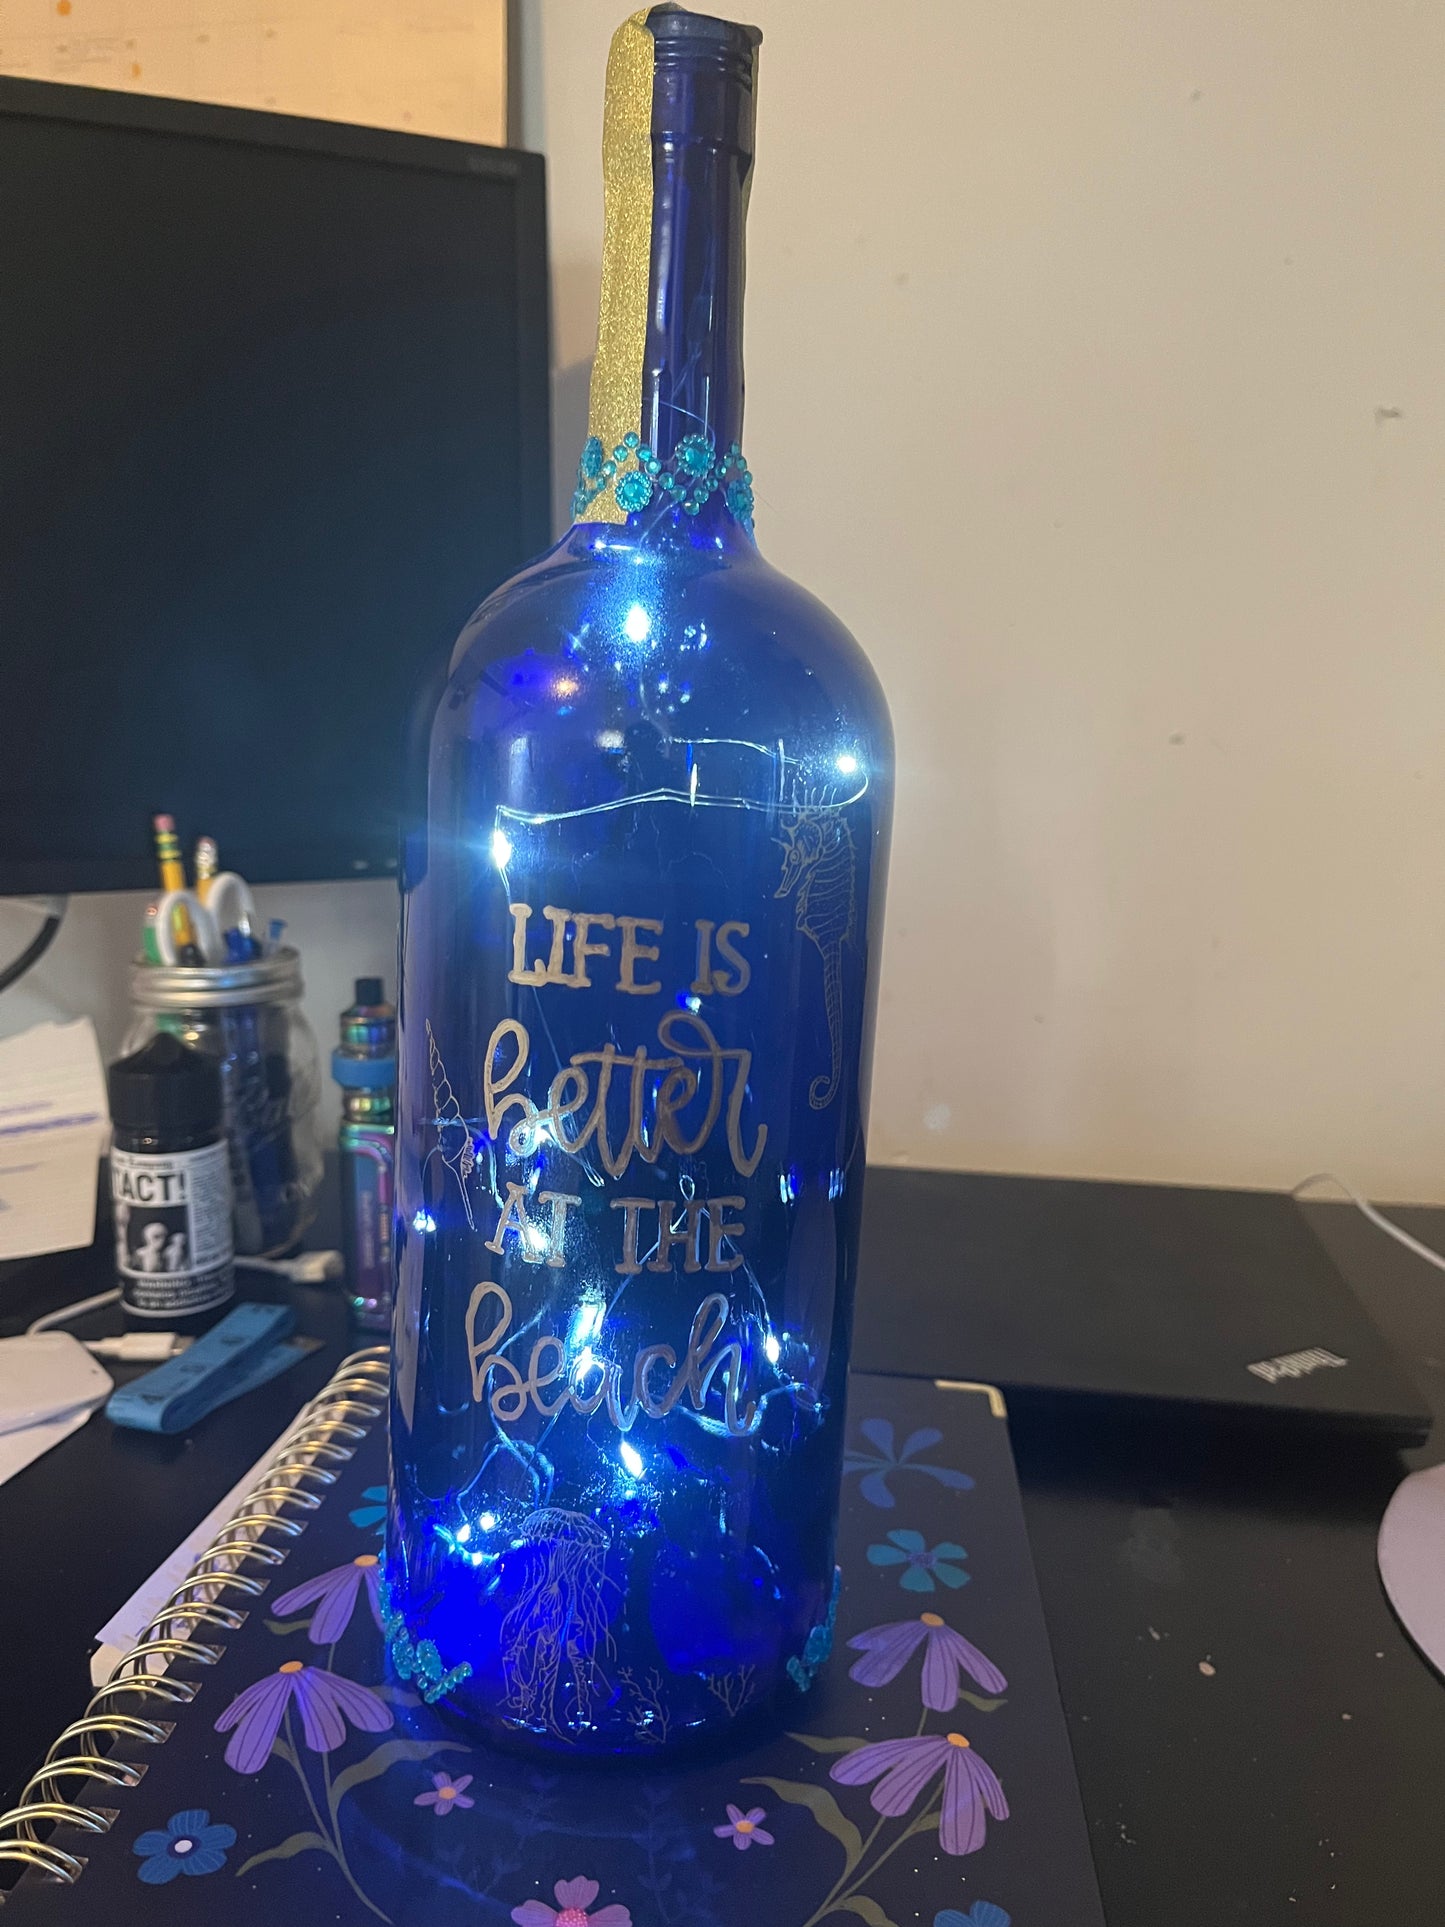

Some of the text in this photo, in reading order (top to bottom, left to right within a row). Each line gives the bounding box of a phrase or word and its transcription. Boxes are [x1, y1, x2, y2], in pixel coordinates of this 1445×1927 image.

[508, 903, 751, 995] LIFE IS
[484, 1010, 768, 1178] better
[484, 1181, 747, 1274] AT THE
[465, 1281, 757, 1437] beach
